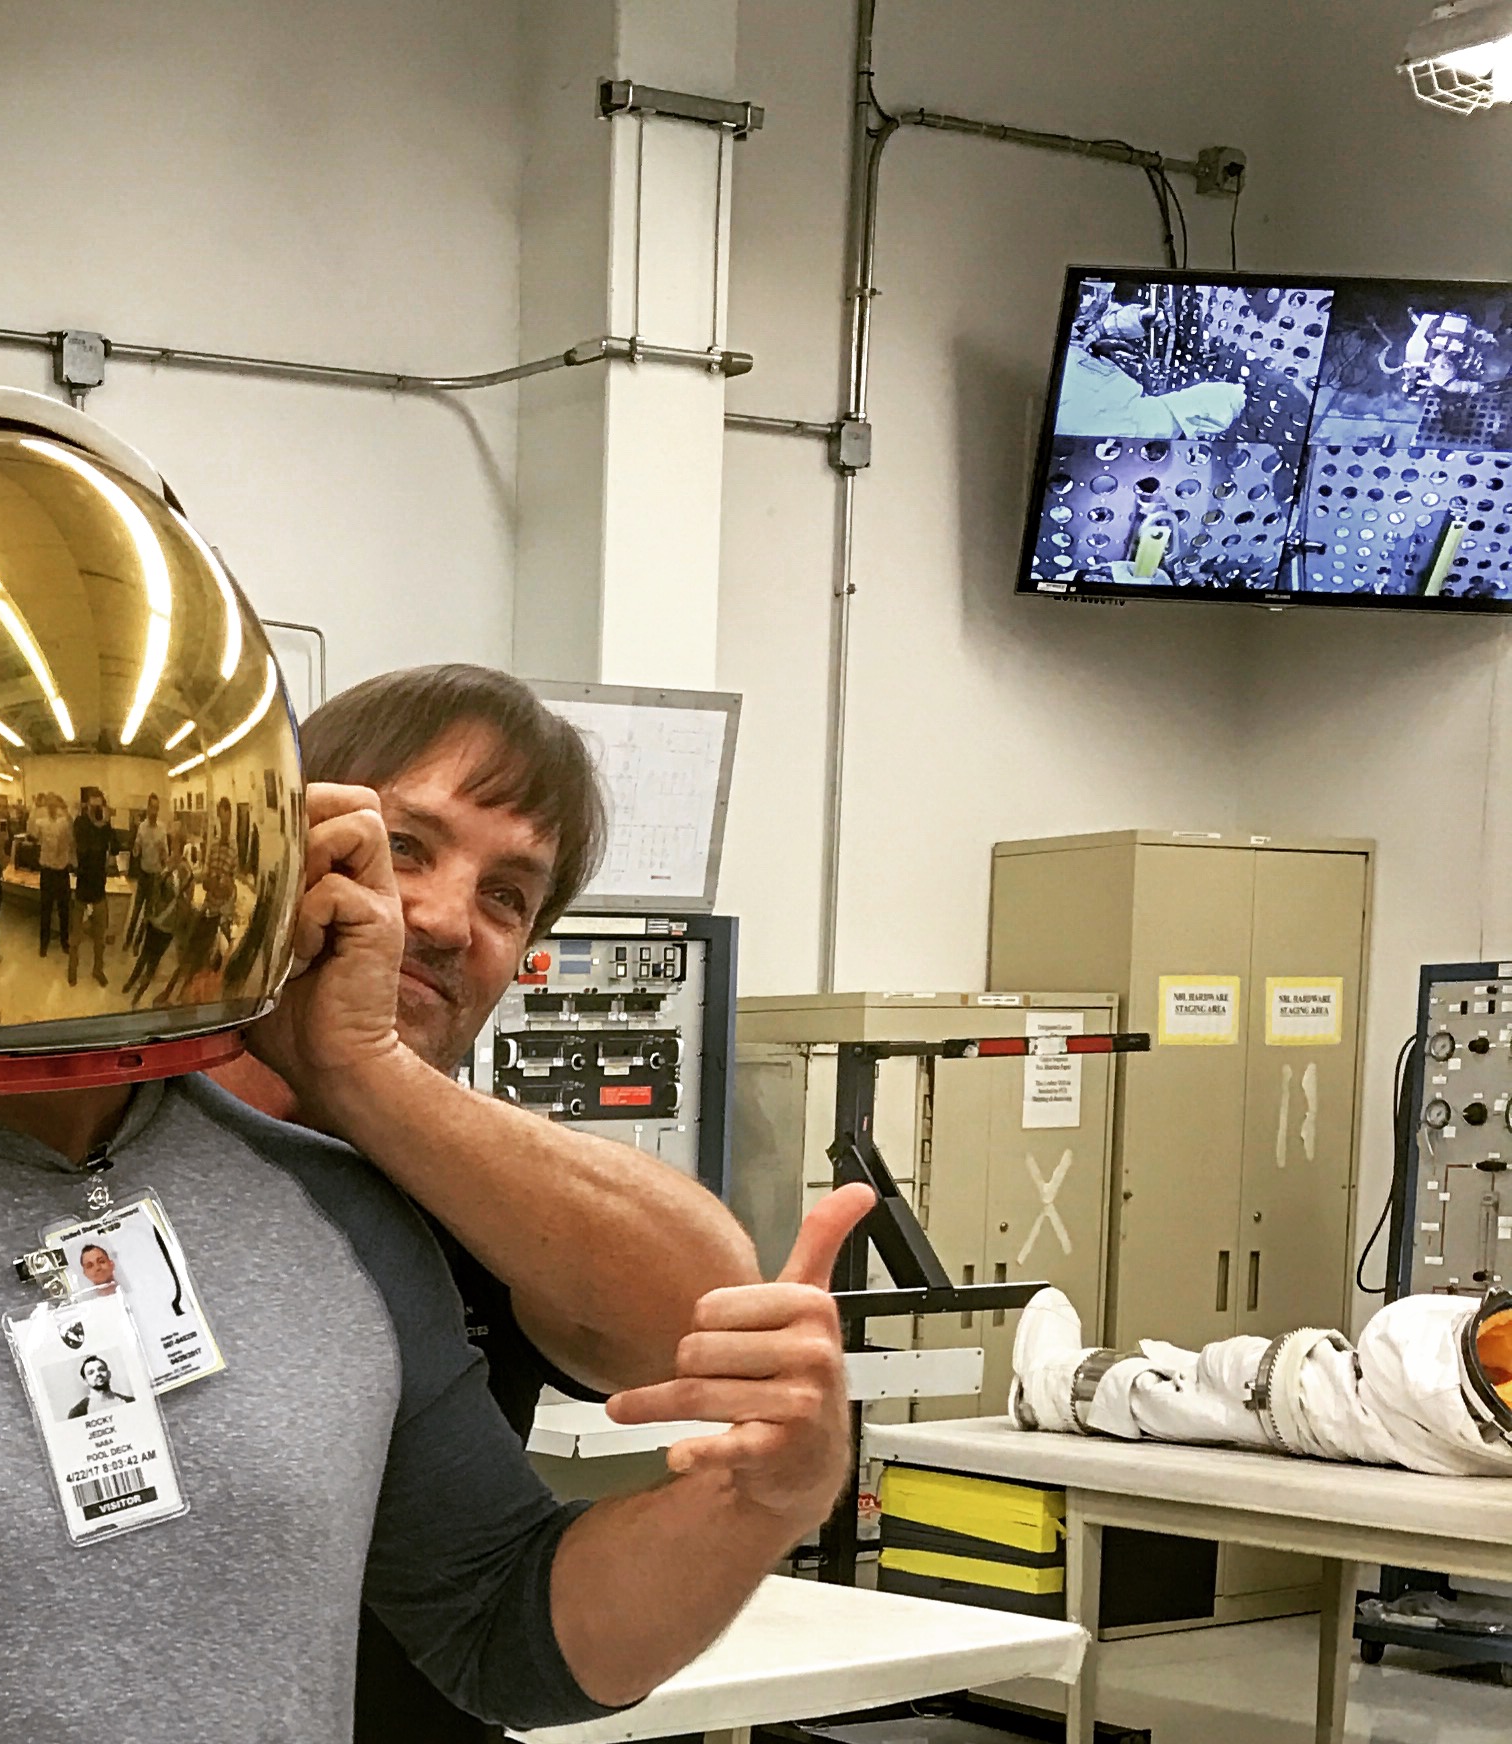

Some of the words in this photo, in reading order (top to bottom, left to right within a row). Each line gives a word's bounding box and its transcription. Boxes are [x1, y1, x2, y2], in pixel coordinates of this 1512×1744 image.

[85, 1414, 113, 1429] ROCKY
[86, 1450, 109, 1462] POOL
[110, 1443, 133, 1457] DECK
[66, 1466, 99, 1482] 4/22/17
[102, 1455, 139, 1473] 8:03:42
[141, 1449, 157, 1462] AM
[99, 1494, 142, 1513] VISITOR
